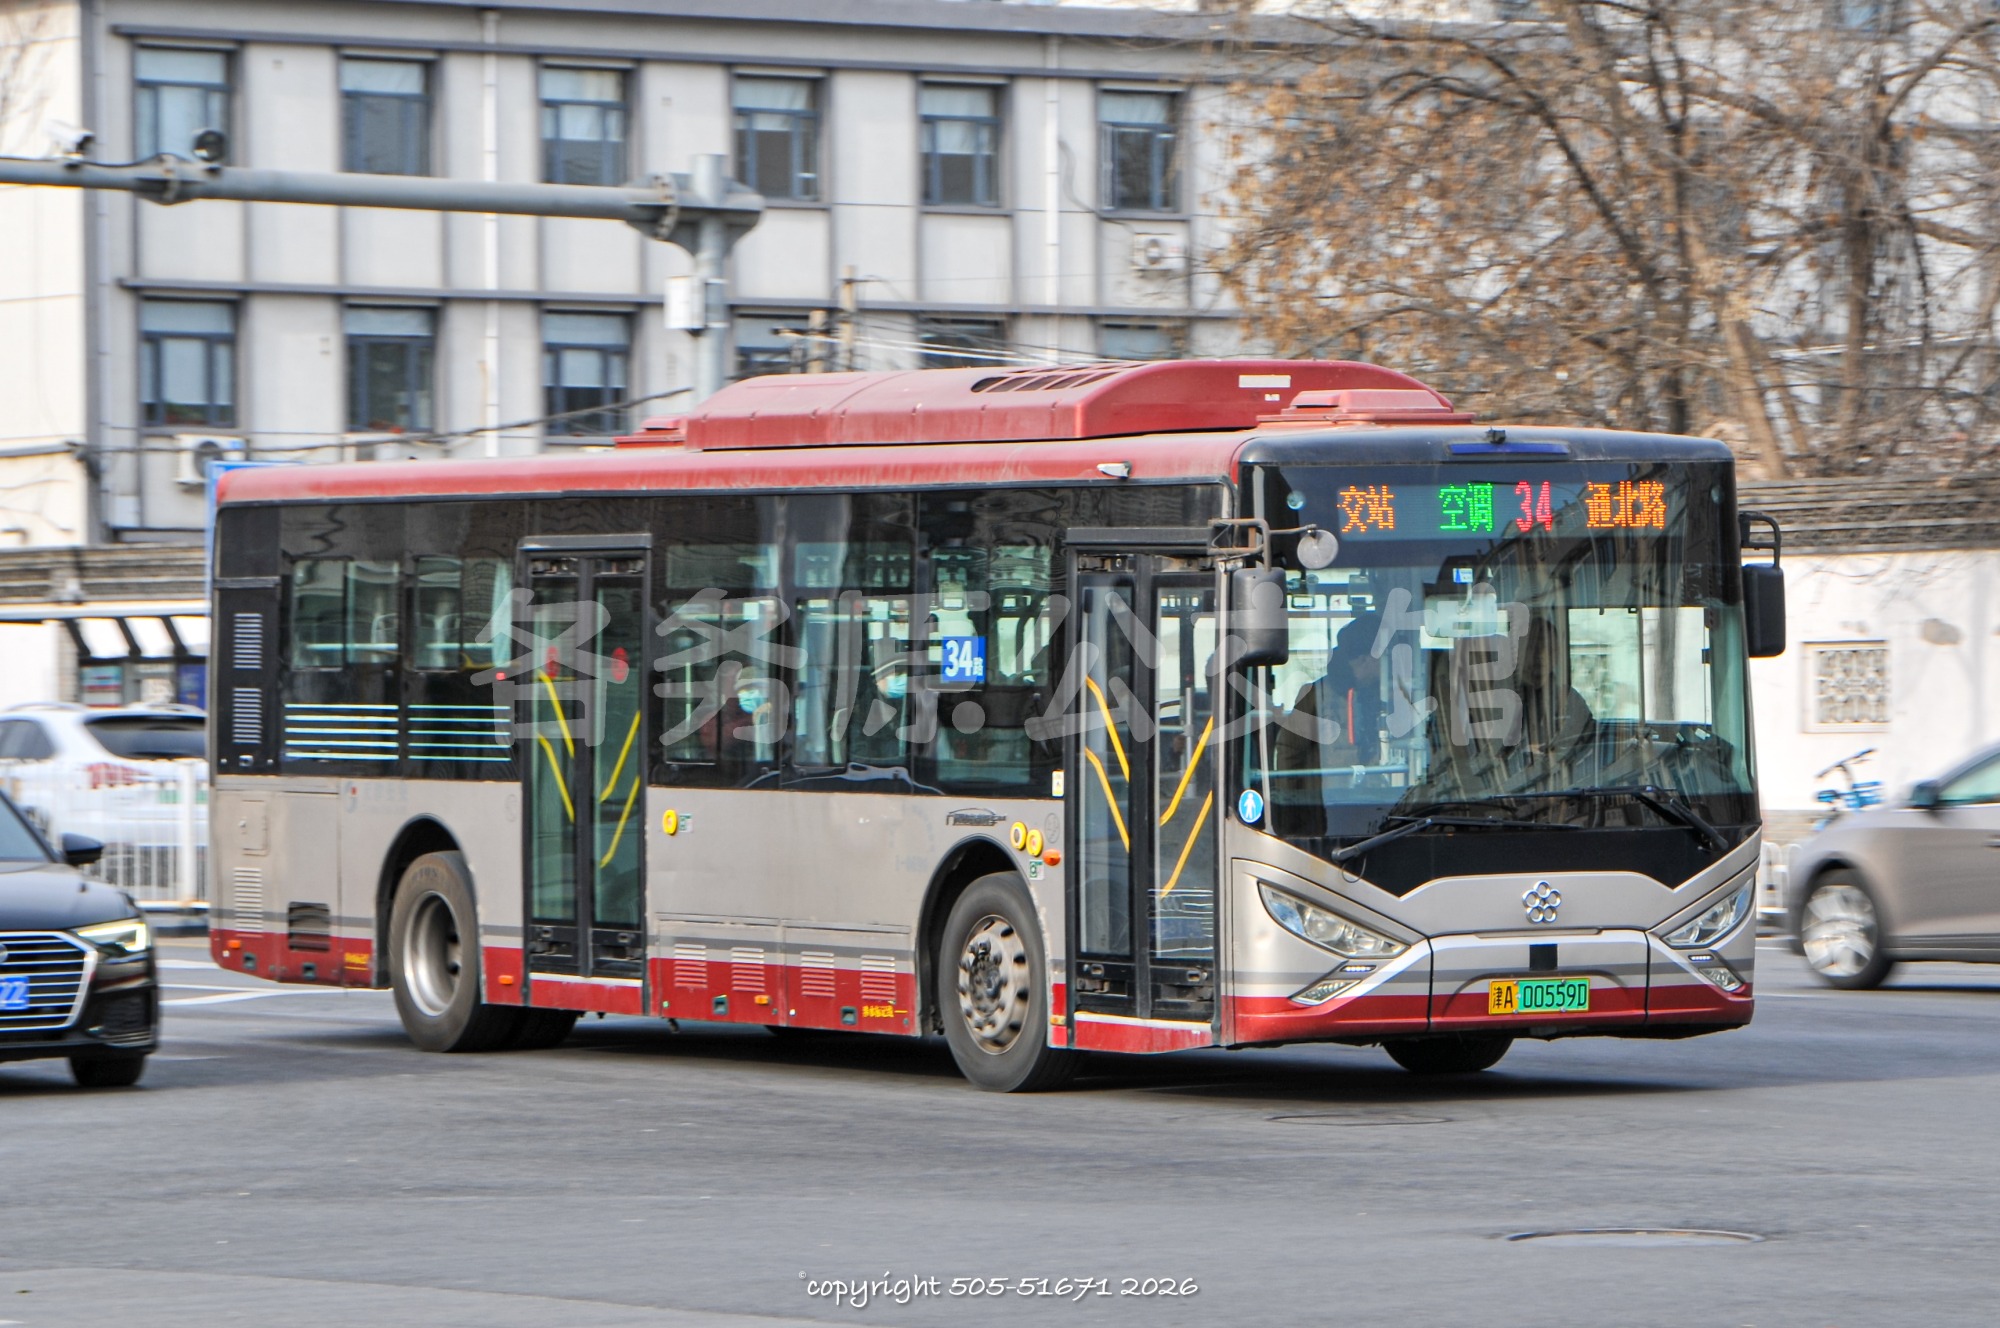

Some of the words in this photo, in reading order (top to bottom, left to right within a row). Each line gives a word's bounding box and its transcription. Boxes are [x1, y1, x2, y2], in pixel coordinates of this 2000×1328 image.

[1337, 484, 1395, 532] 交站
[1437, 482, 1494, 533] 空调
[1515, 480, 1553, 532] 34
[1585, 480, 1667, 530] 通北路
